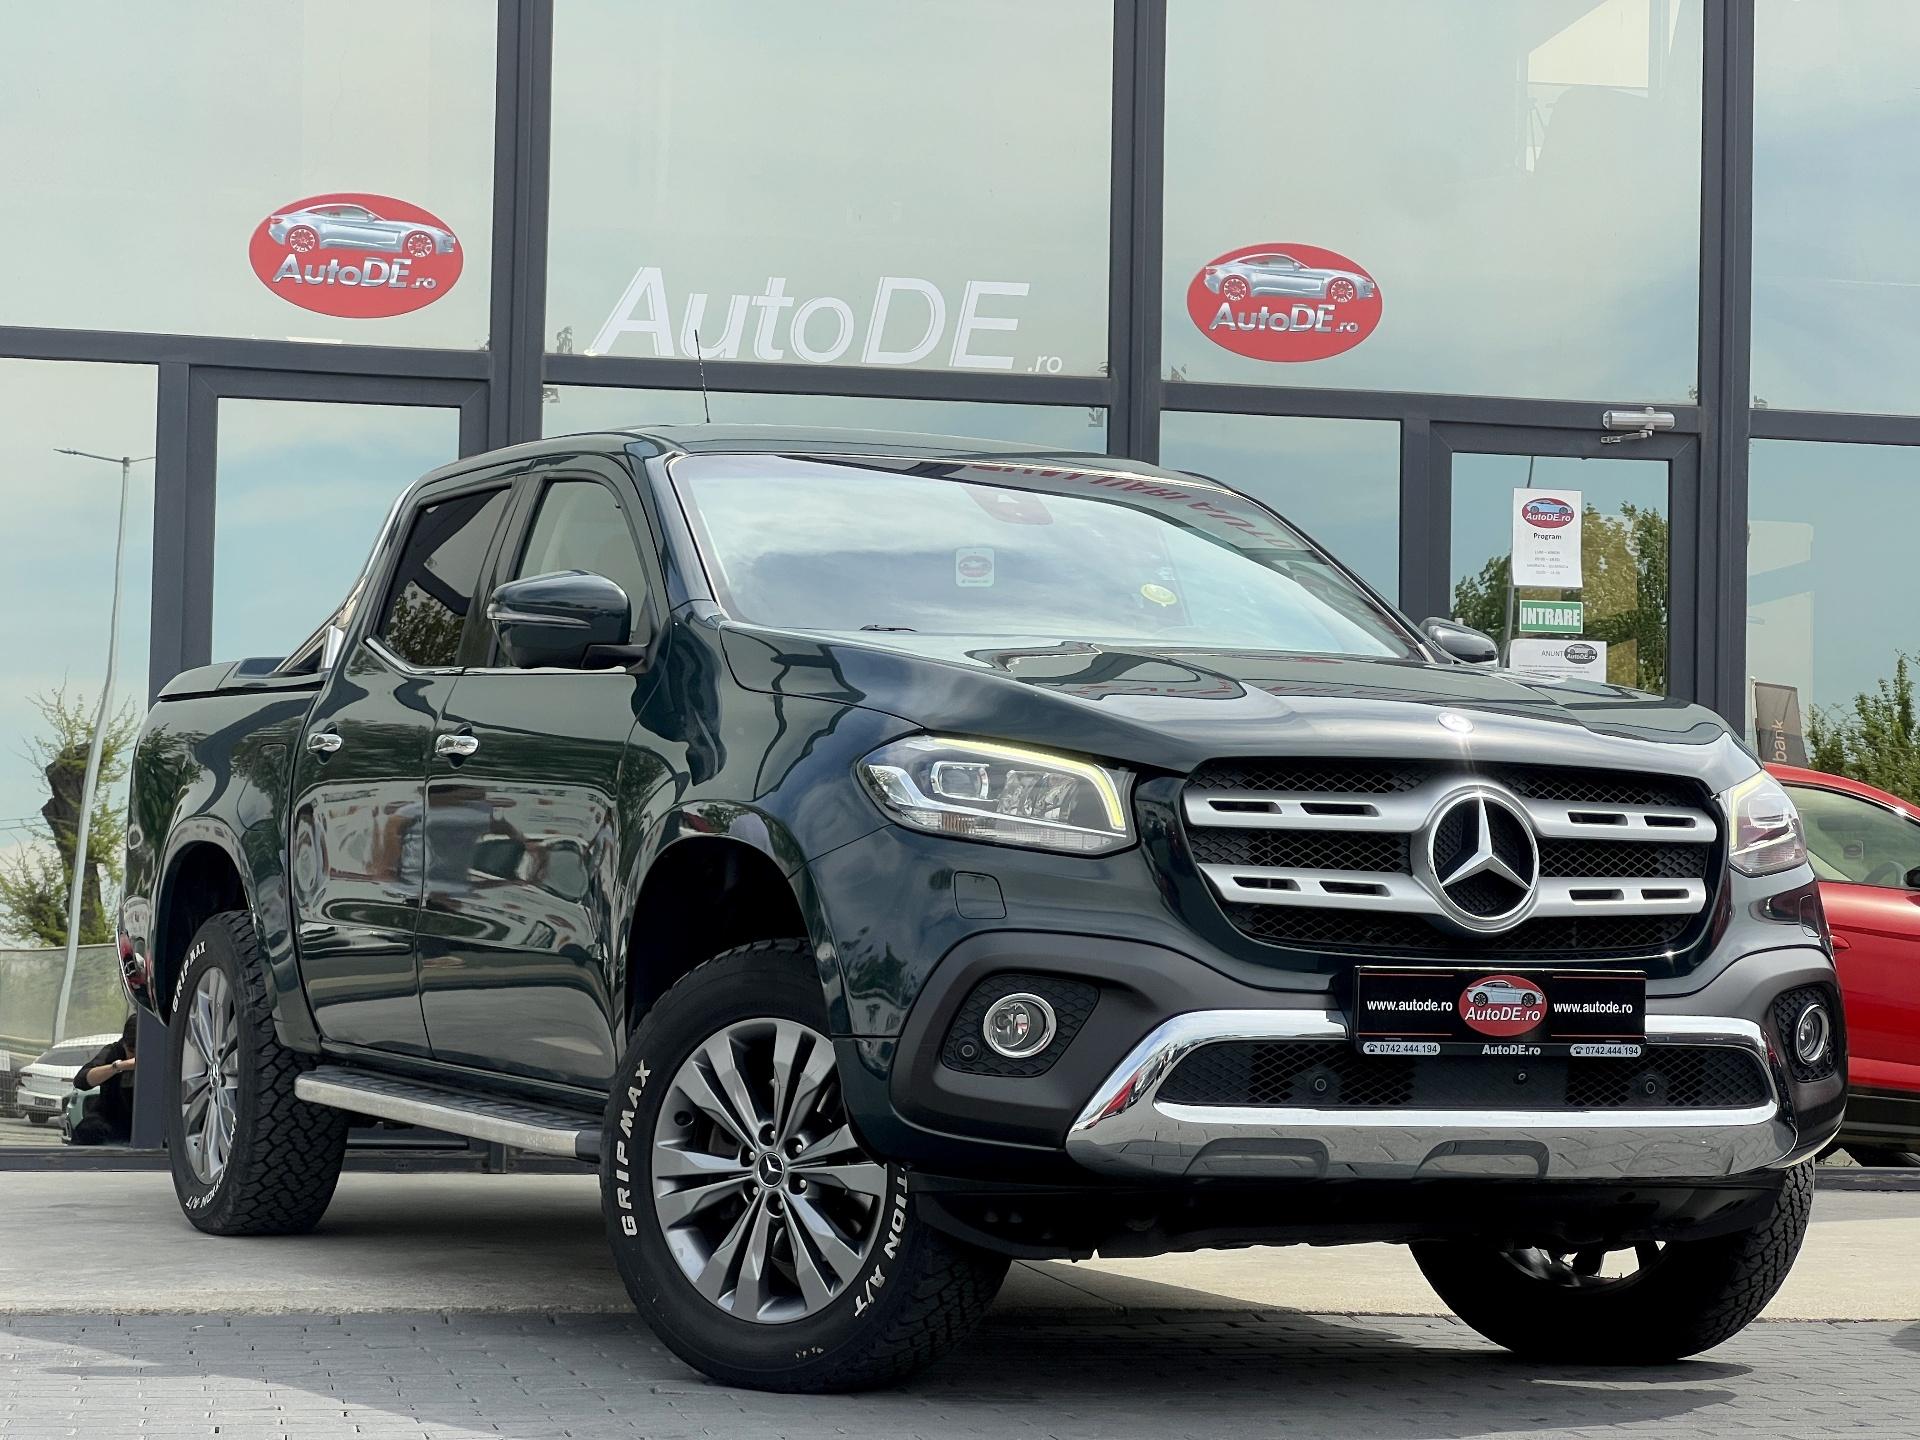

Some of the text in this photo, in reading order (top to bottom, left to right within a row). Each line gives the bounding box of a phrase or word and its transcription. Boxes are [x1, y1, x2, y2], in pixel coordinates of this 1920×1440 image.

[1533, 532, 1562, 541] Program
[1522, 607, 1581, 627] INTRARE
[1771, 719, 1788, 763] bank
[1366, 999, 1453, 1012] www.autode.ro
[1553, 1001, 1633, 1014] www.autode.ro
[1464, 1007, 1541, 1022] AutoDE.ro
[1379, 1043, 1437, 1053] 0742.444.194
[1481, 1044, 1541, 1055] AutoDE.ro
[1585, 1046, 1639, 1055] 0742.444.194
[617, 1059, 651, 1236] GRIPMAX
[854, 1264, 886, 1317] A/T
